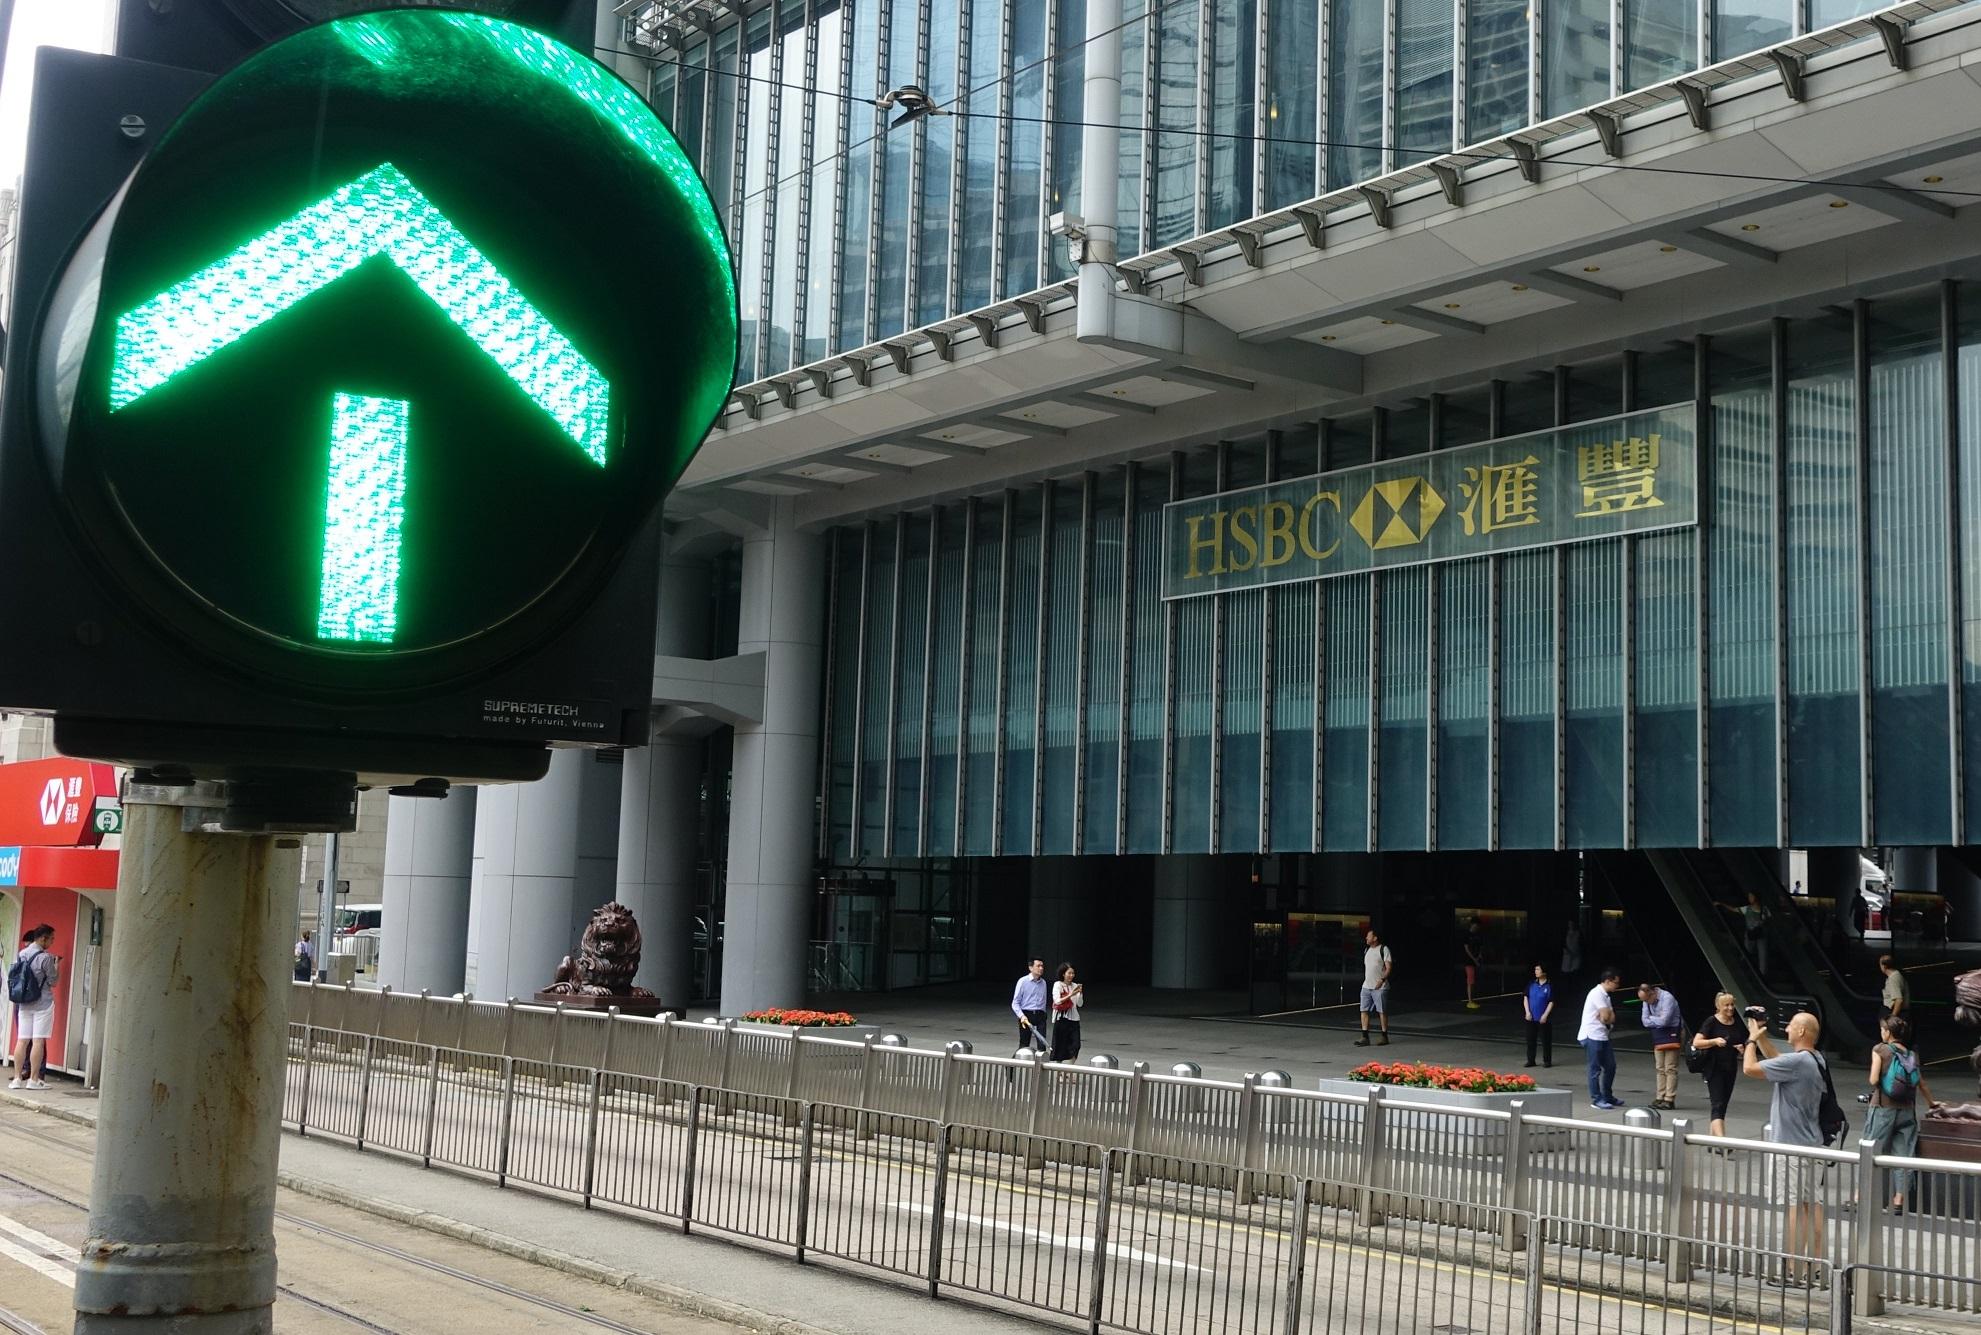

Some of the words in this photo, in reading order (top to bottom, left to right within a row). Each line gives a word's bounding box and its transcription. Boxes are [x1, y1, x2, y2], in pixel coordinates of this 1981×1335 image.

[1184, 490, 1341, 579] HSBC
[484, 700, 579, 716] SUPREMETECH
[483, 715, 510, 723] made
[515, 716, 527, 726] by
[572, 719, 605, 729] Vienna
